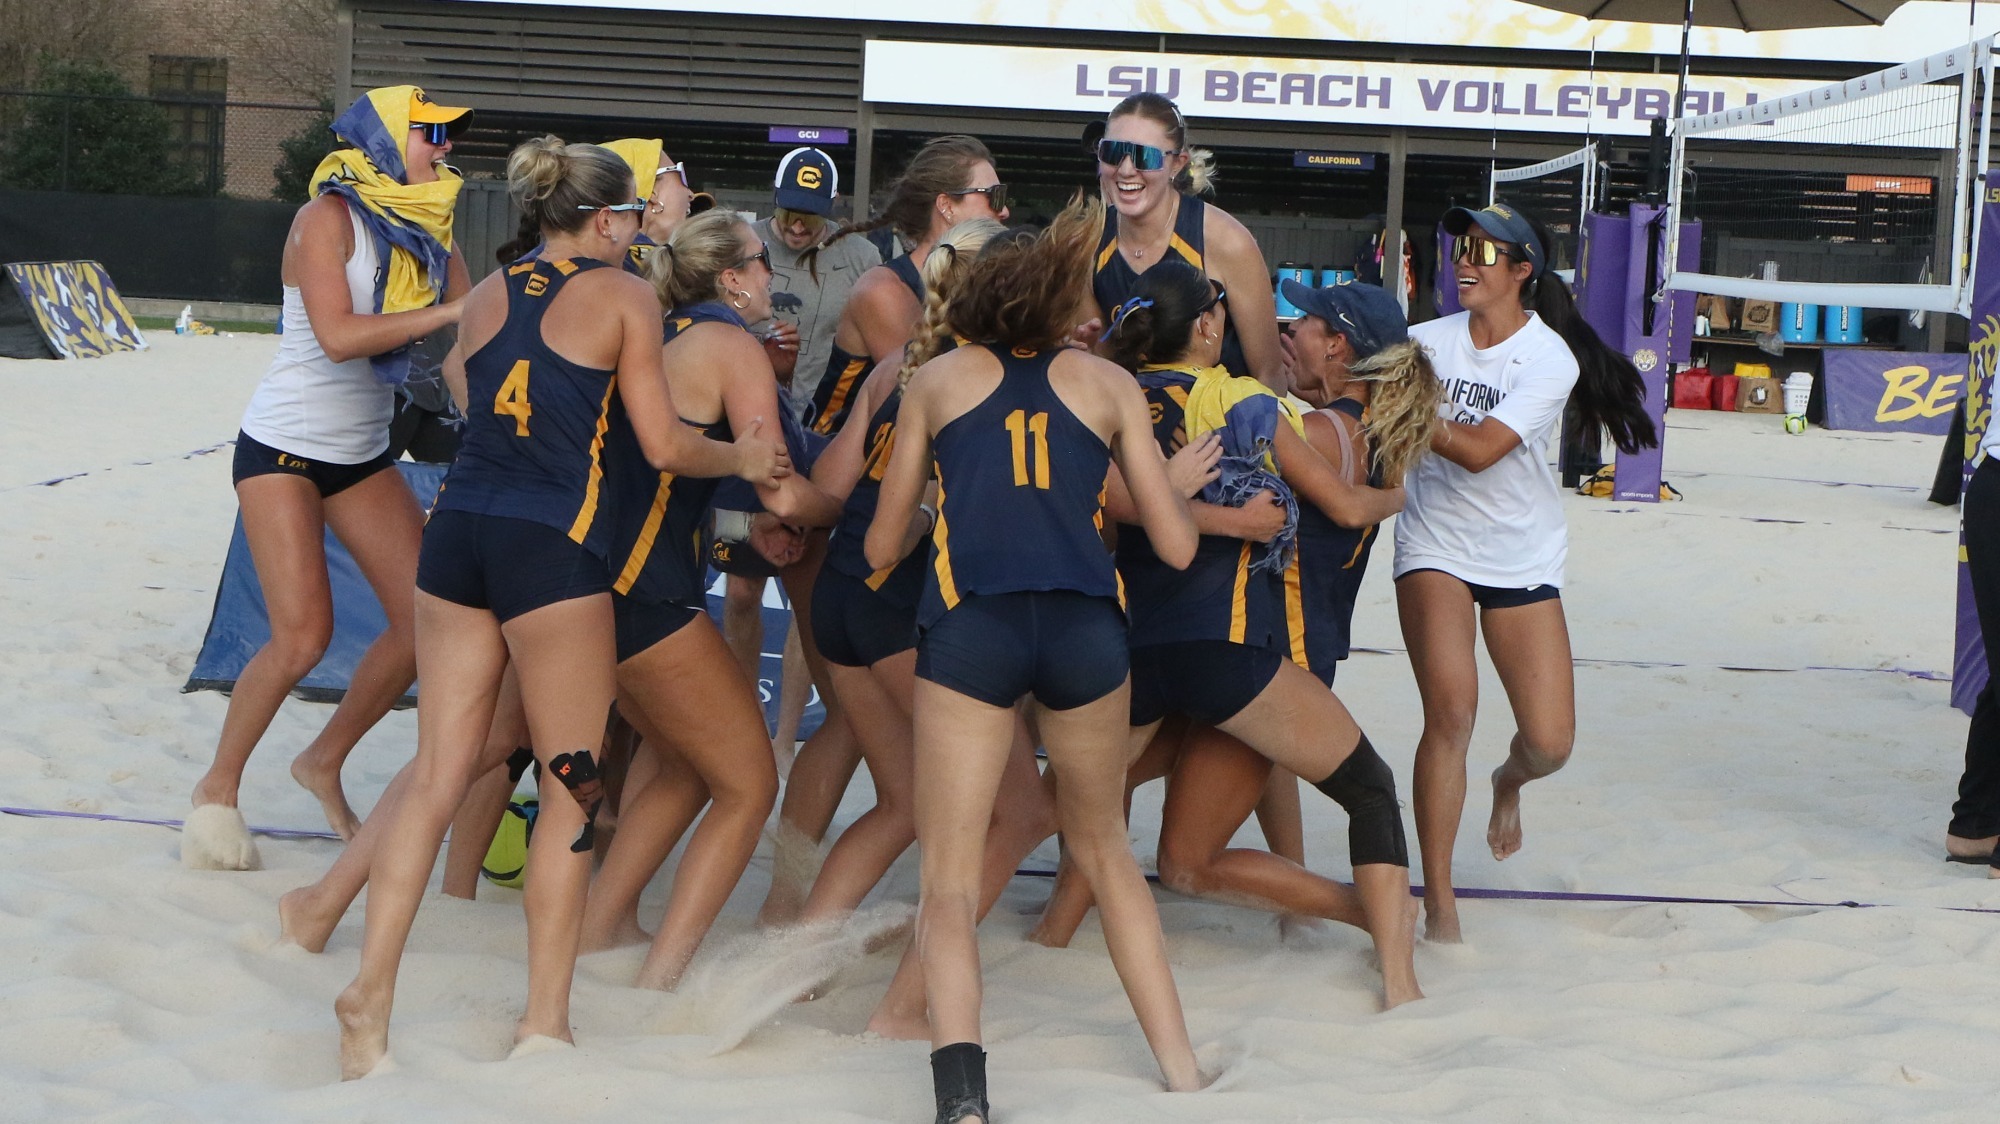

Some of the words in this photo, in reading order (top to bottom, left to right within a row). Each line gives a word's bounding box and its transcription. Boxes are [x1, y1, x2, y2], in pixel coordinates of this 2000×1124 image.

[1076, 64, 1181, 98] LSU
[1204, 69, 1391, 109] BEACH
[798, 130, 819, 139] GCU
[1308, 155, 1361, 165] CALIFORNIA
[1984, 187, 2000, 203] LS
[494, 359, 532, 437] 4
[1004, 409, 1050, 490] 11
[712, 542, 731, 561] Cal
